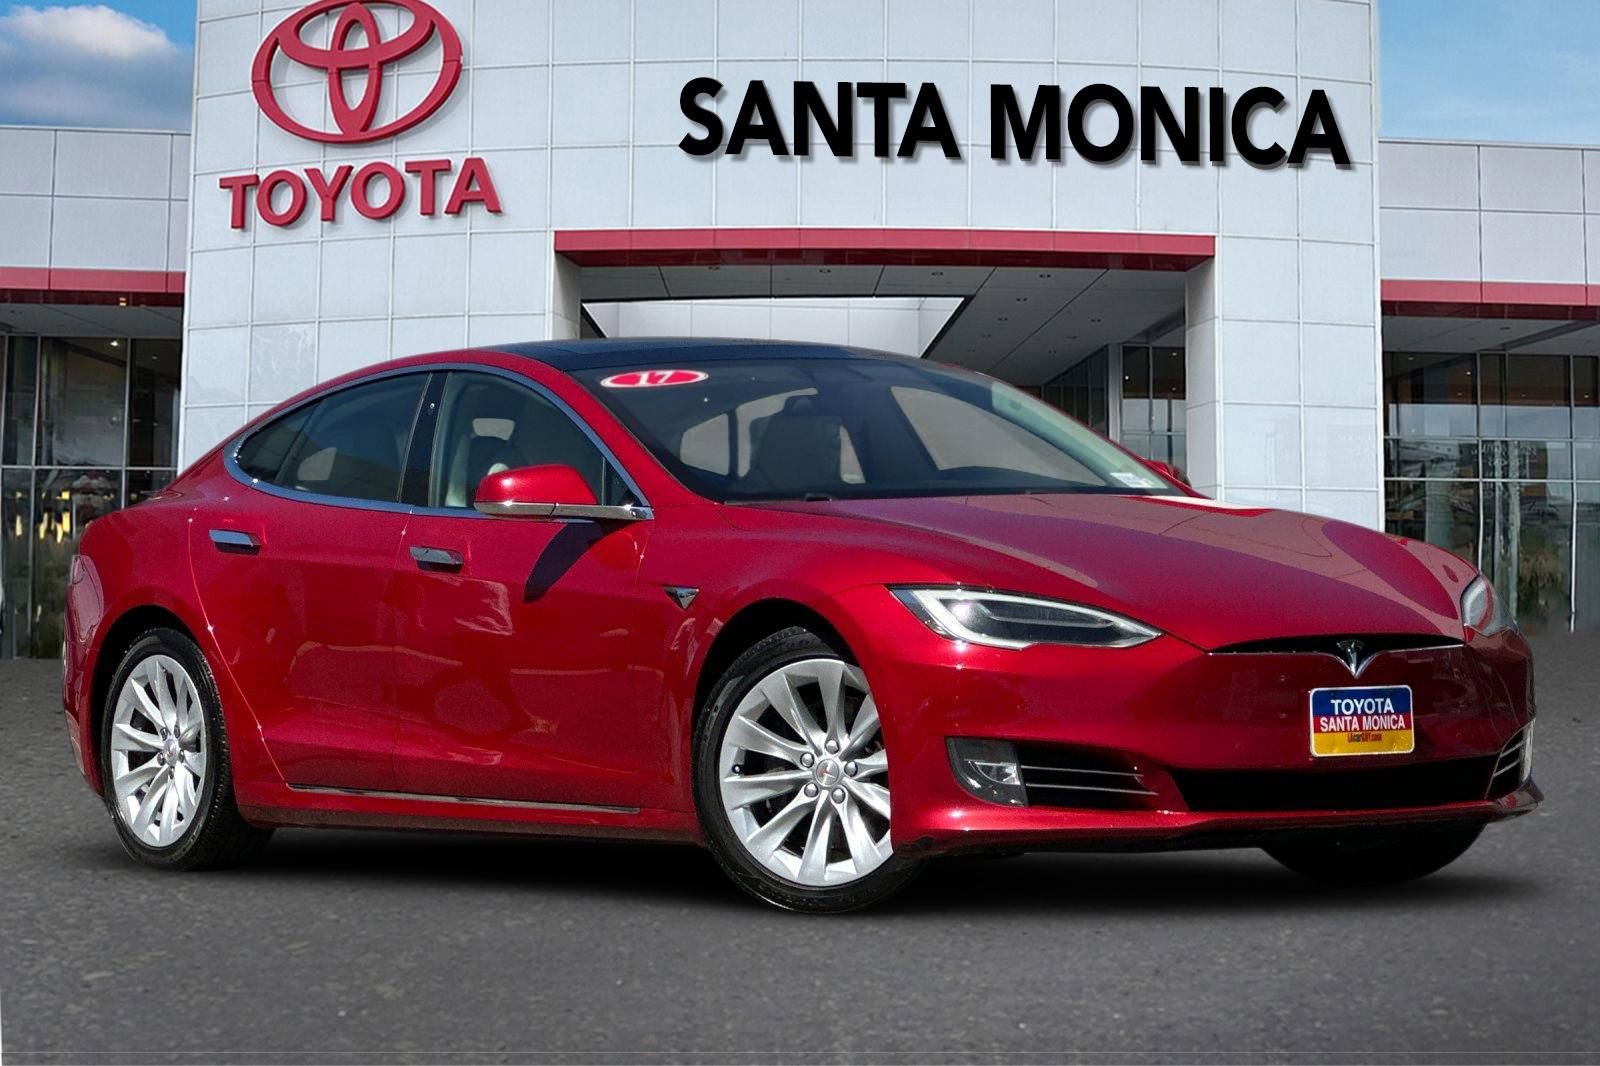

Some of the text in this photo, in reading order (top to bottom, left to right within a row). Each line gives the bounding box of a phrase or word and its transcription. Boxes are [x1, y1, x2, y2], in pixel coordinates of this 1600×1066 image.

[678, 77, 1351, 168] SANTA MONICA
[219, 157, 502, 229] TOYOTA
[638, 370, 676, 386] 17
[1330, 698, 1395, 716] TOYOTA
[1320, 714, 1406, 732] SANTA MONICA
